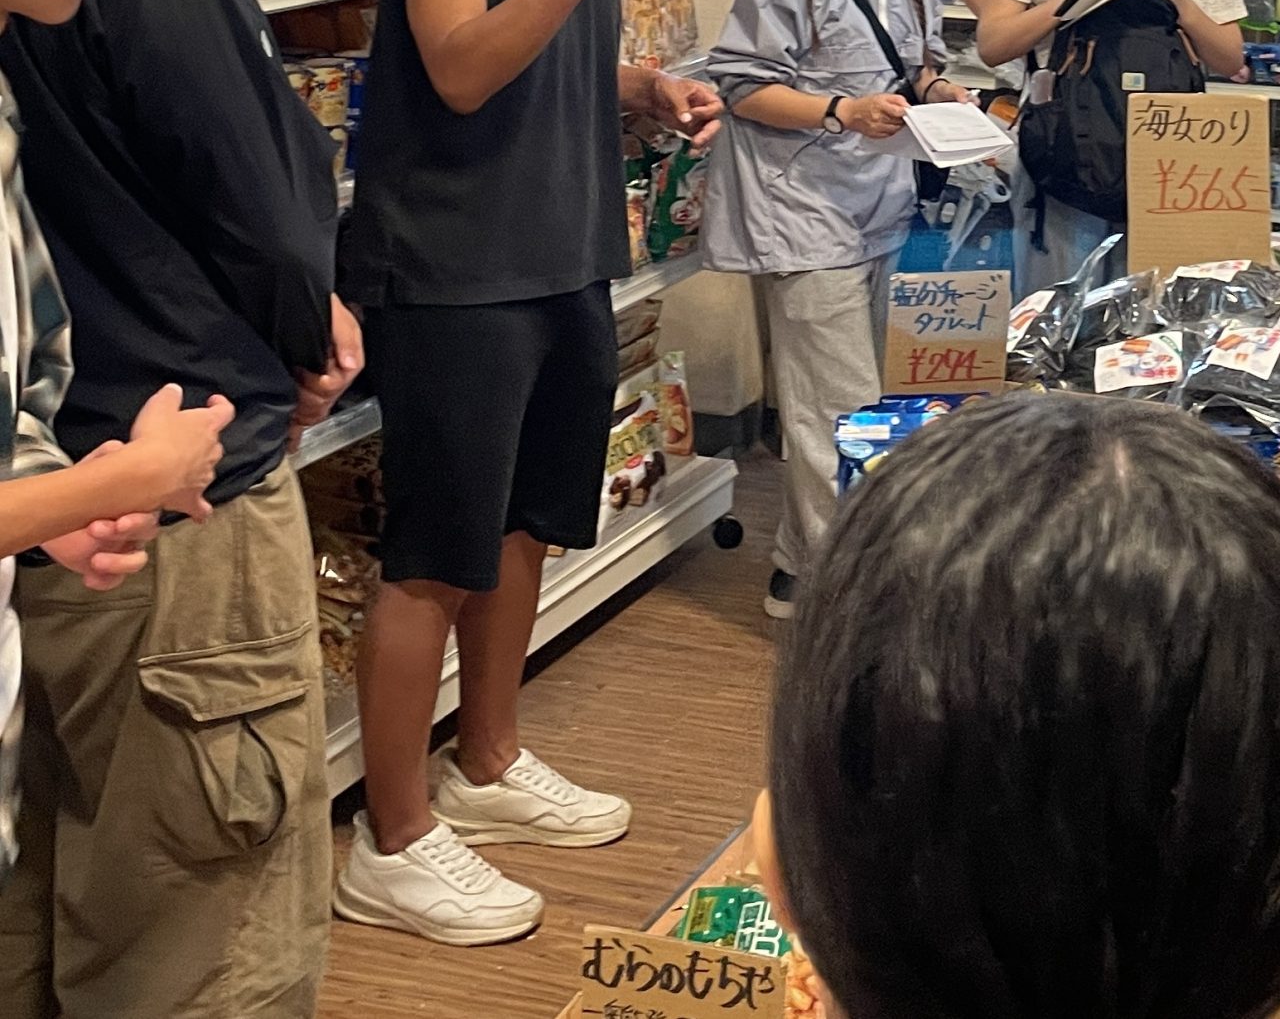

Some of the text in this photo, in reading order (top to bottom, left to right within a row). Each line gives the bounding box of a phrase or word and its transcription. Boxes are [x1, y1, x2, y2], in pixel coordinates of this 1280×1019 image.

[1132, 99, 1250, 146] 海女のり
[914, 303, 998, 335] タブレット
